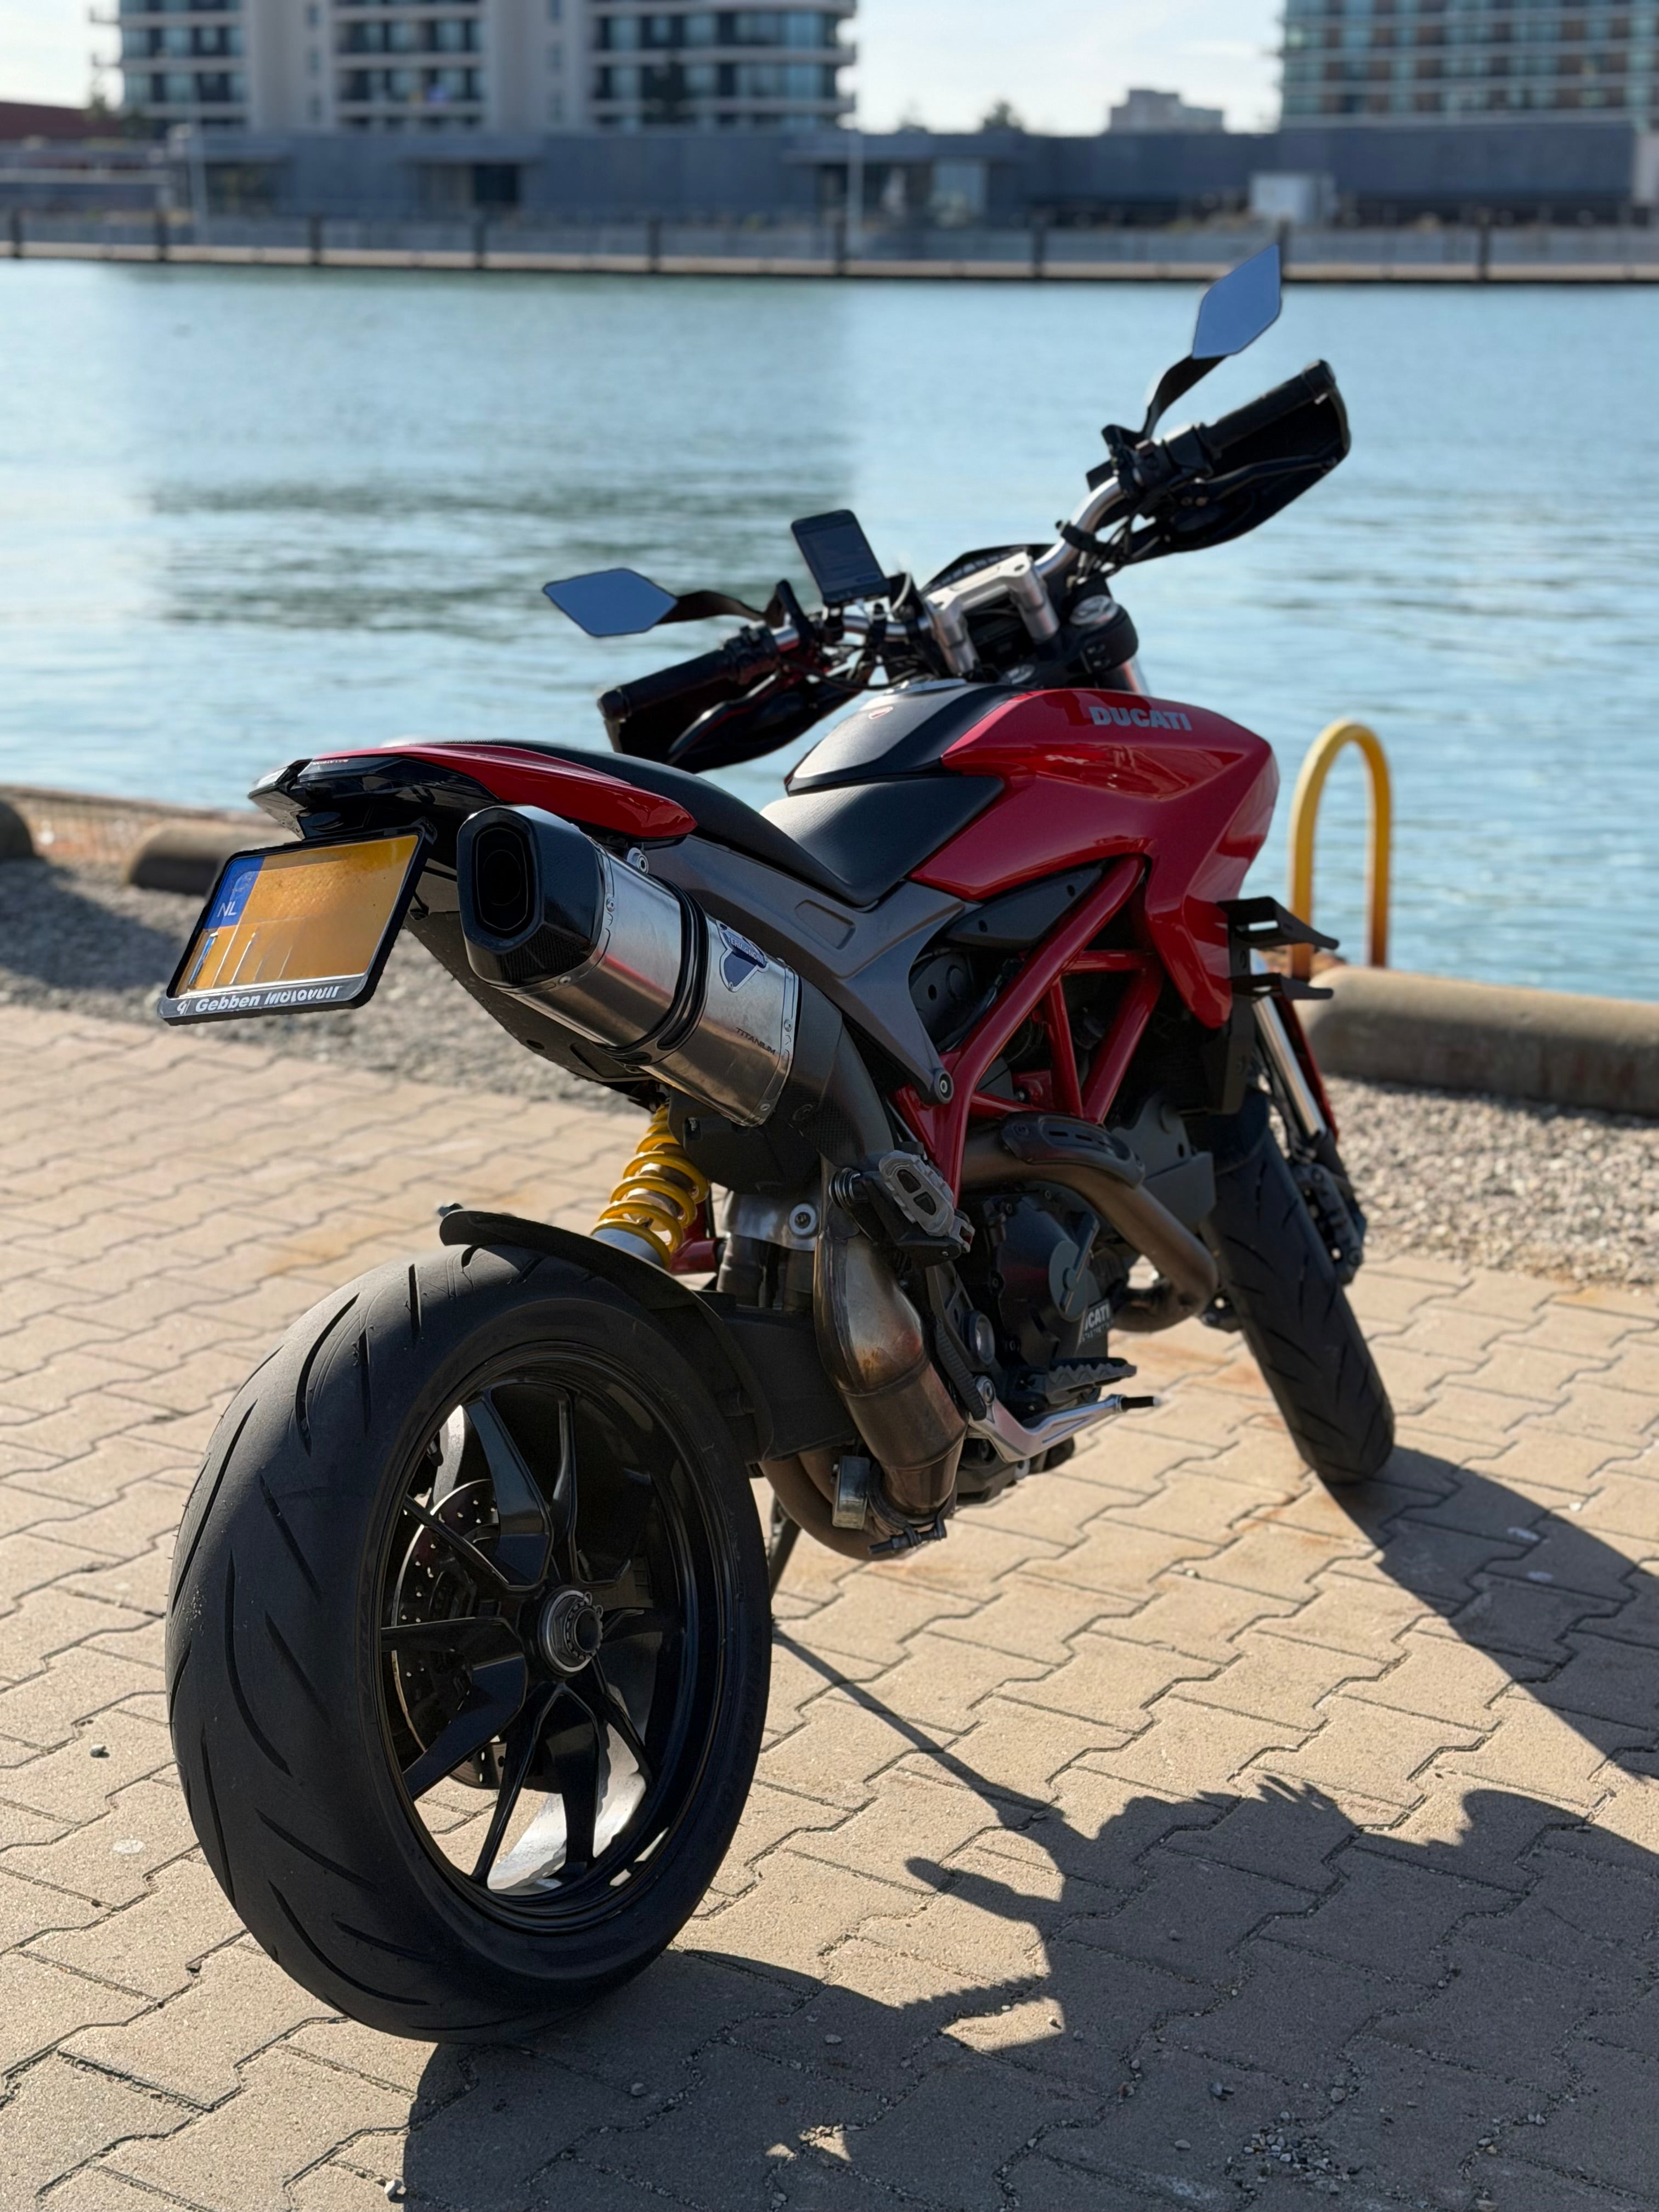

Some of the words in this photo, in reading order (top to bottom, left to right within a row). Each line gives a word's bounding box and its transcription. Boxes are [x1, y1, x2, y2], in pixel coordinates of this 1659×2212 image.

[1088, 706, 1192, 731] DUCATI
[217, 900, 237, 918] NL
[195, 994, 261, 1013] Gebben
[736, 1026, 776, 1055] TITANIUM
